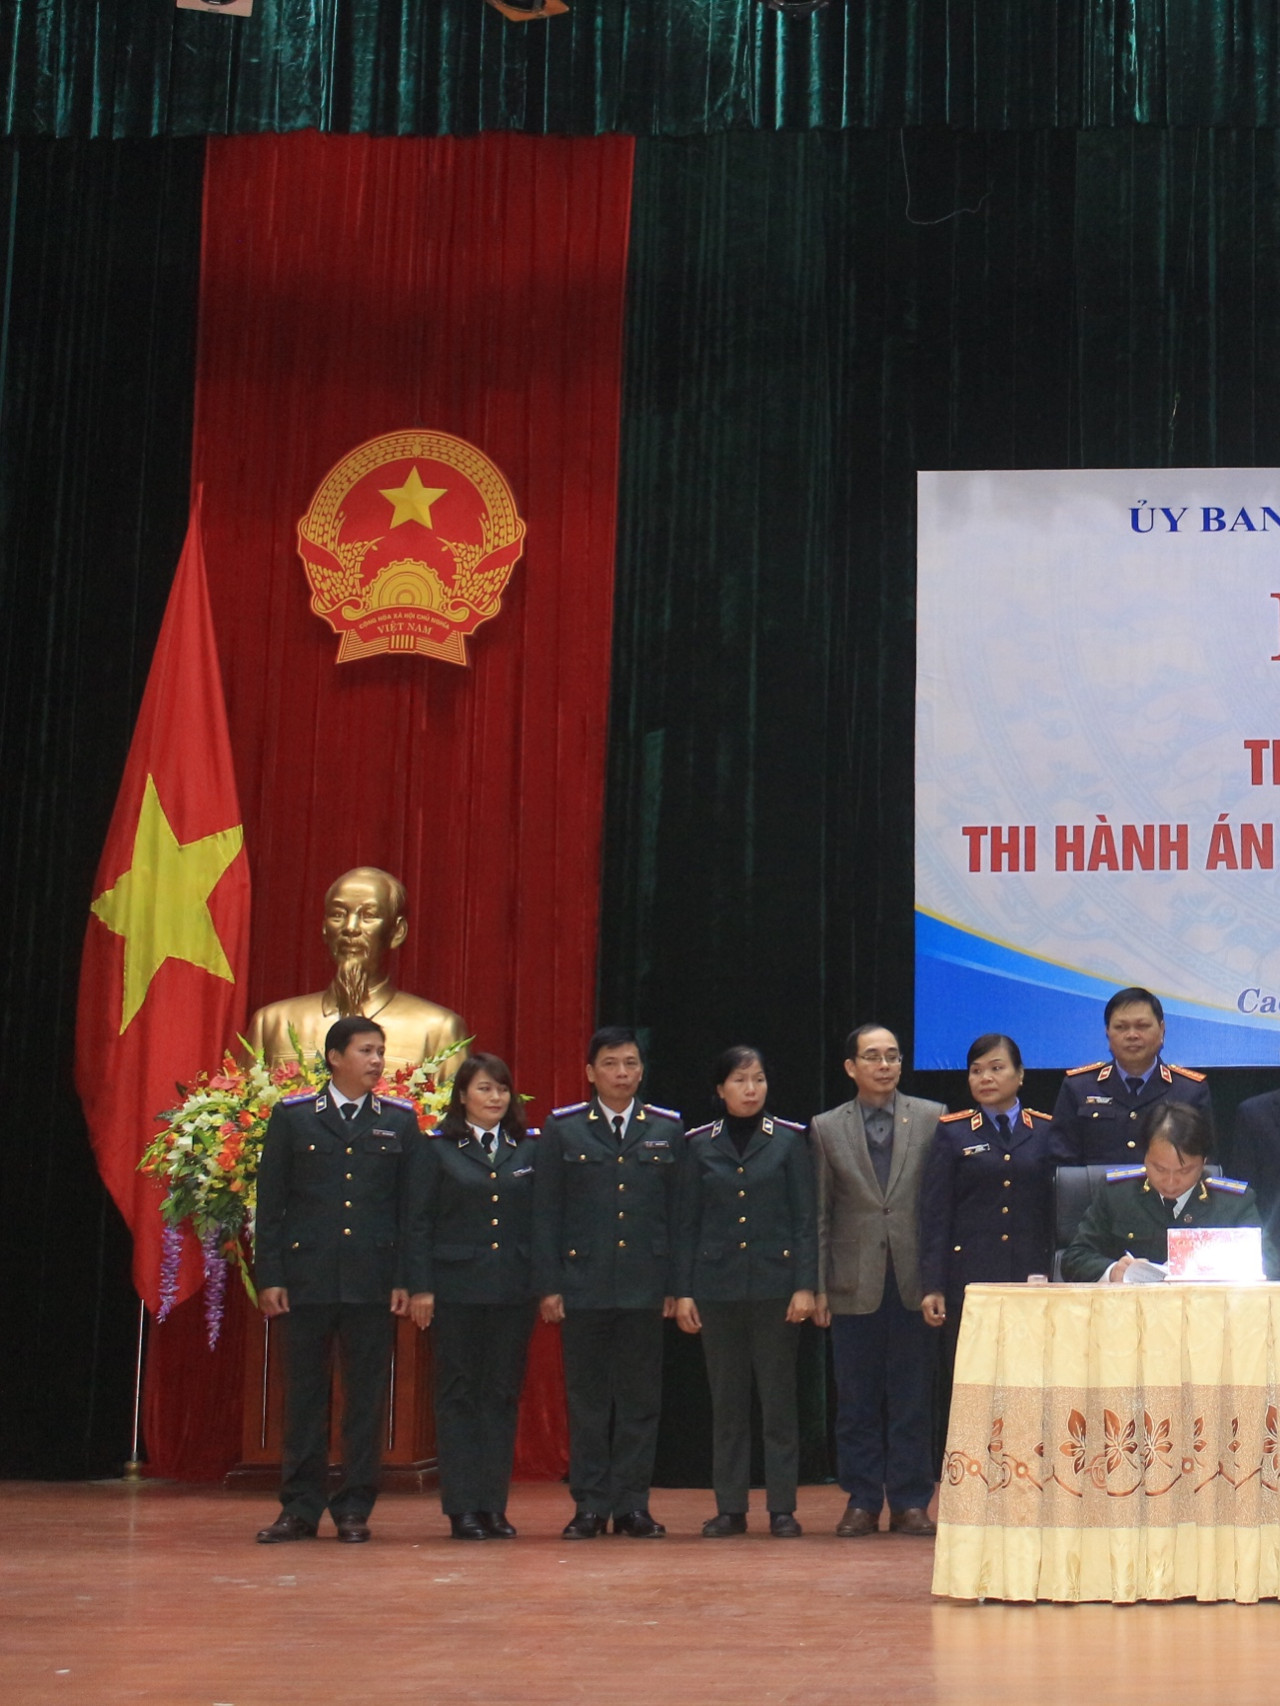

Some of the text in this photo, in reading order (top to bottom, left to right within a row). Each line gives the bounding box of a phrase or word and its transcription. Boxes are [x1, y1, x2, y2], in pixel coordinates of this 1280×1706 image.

[1129, 500, 1188, 533] ỦY
[377, 620, 432, 635] VIỆT NAM
[963, 826, 1036, 872] THI
[1055, 814, 1189, 872] HÀNH
[1205, 813, 1274, 870] ÁN
